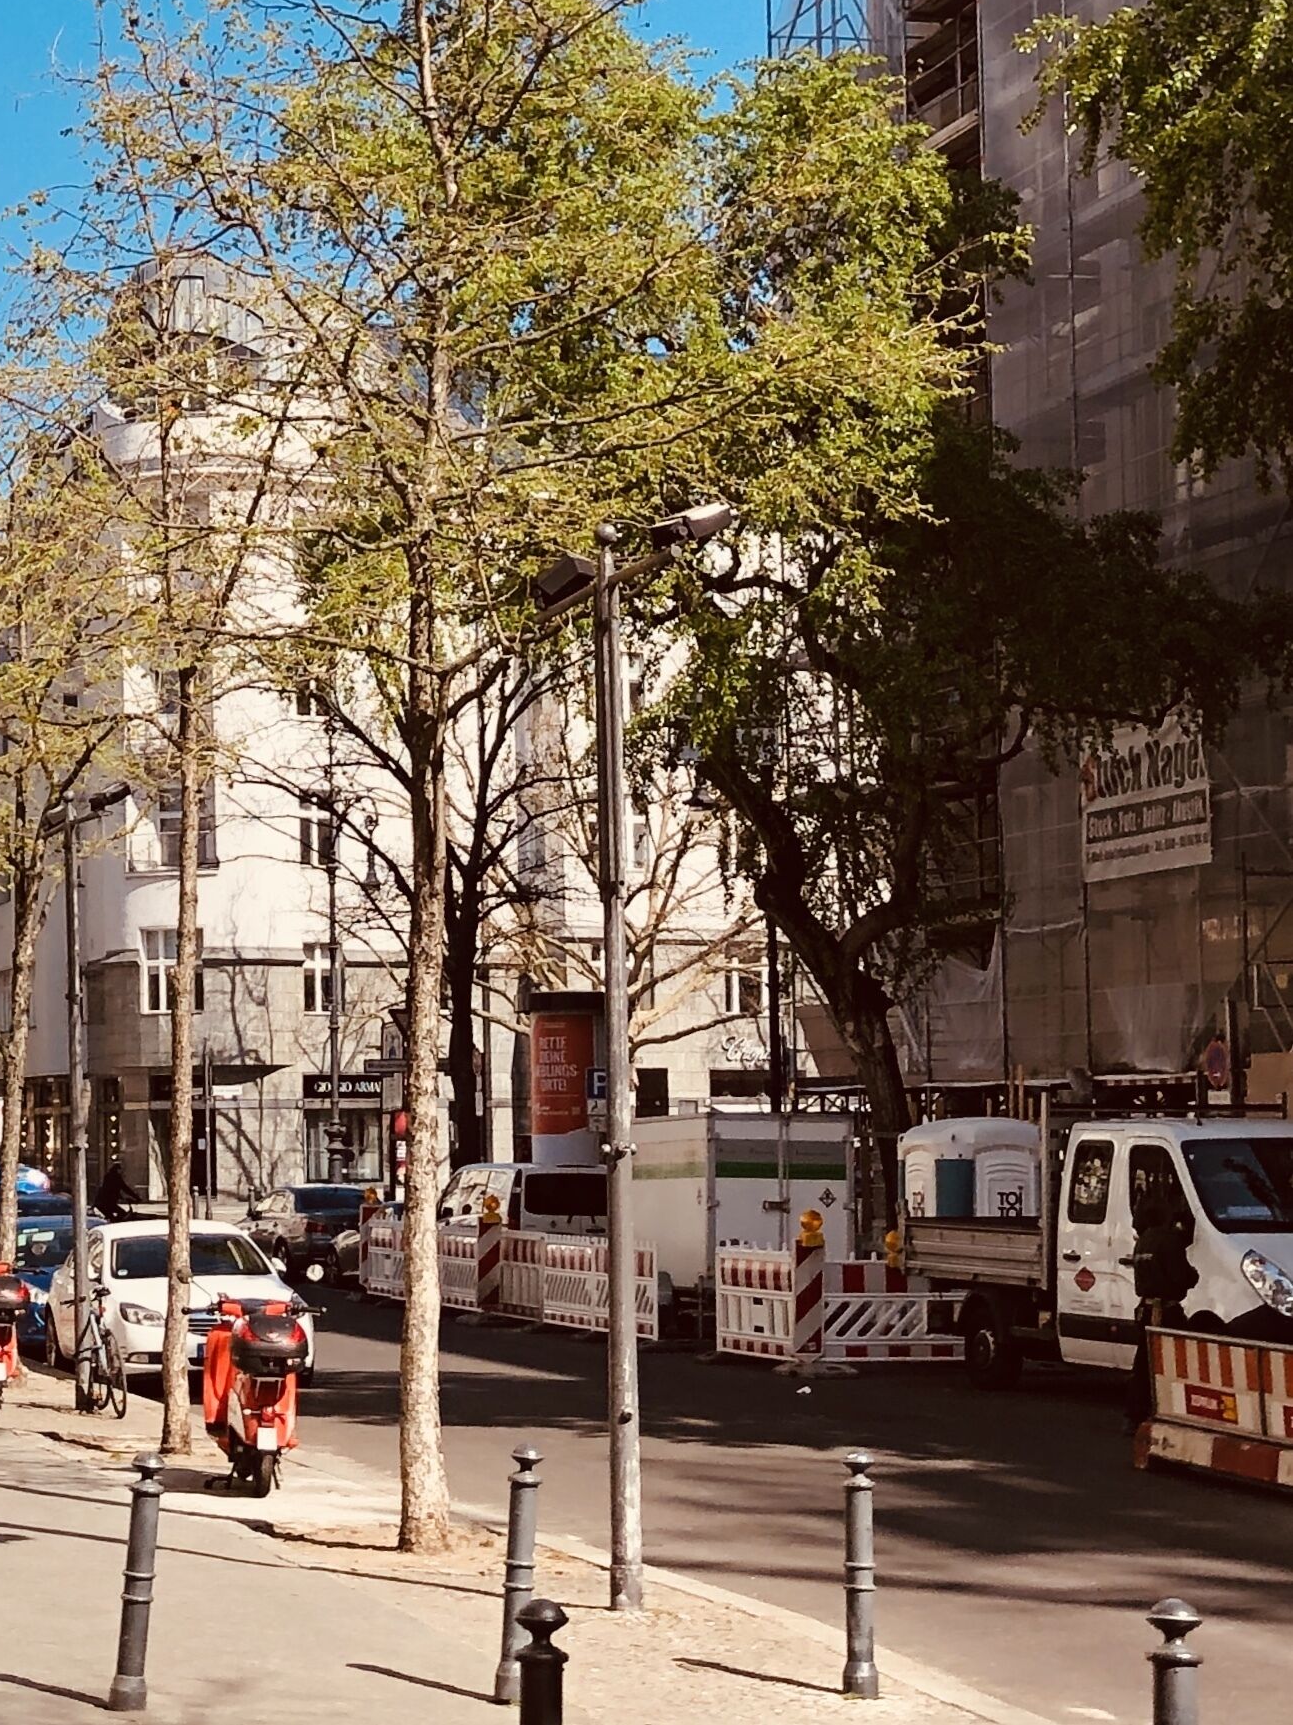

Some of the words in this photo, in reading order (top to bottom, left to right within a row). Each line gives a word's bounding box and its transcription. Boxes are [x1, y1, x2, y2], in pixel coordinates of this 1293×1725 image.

[314, 1081, 353, 1093] GIOGIO
[354, 1081, 382, 1093] ARMA
[593, 1071, 607, 1096] P
